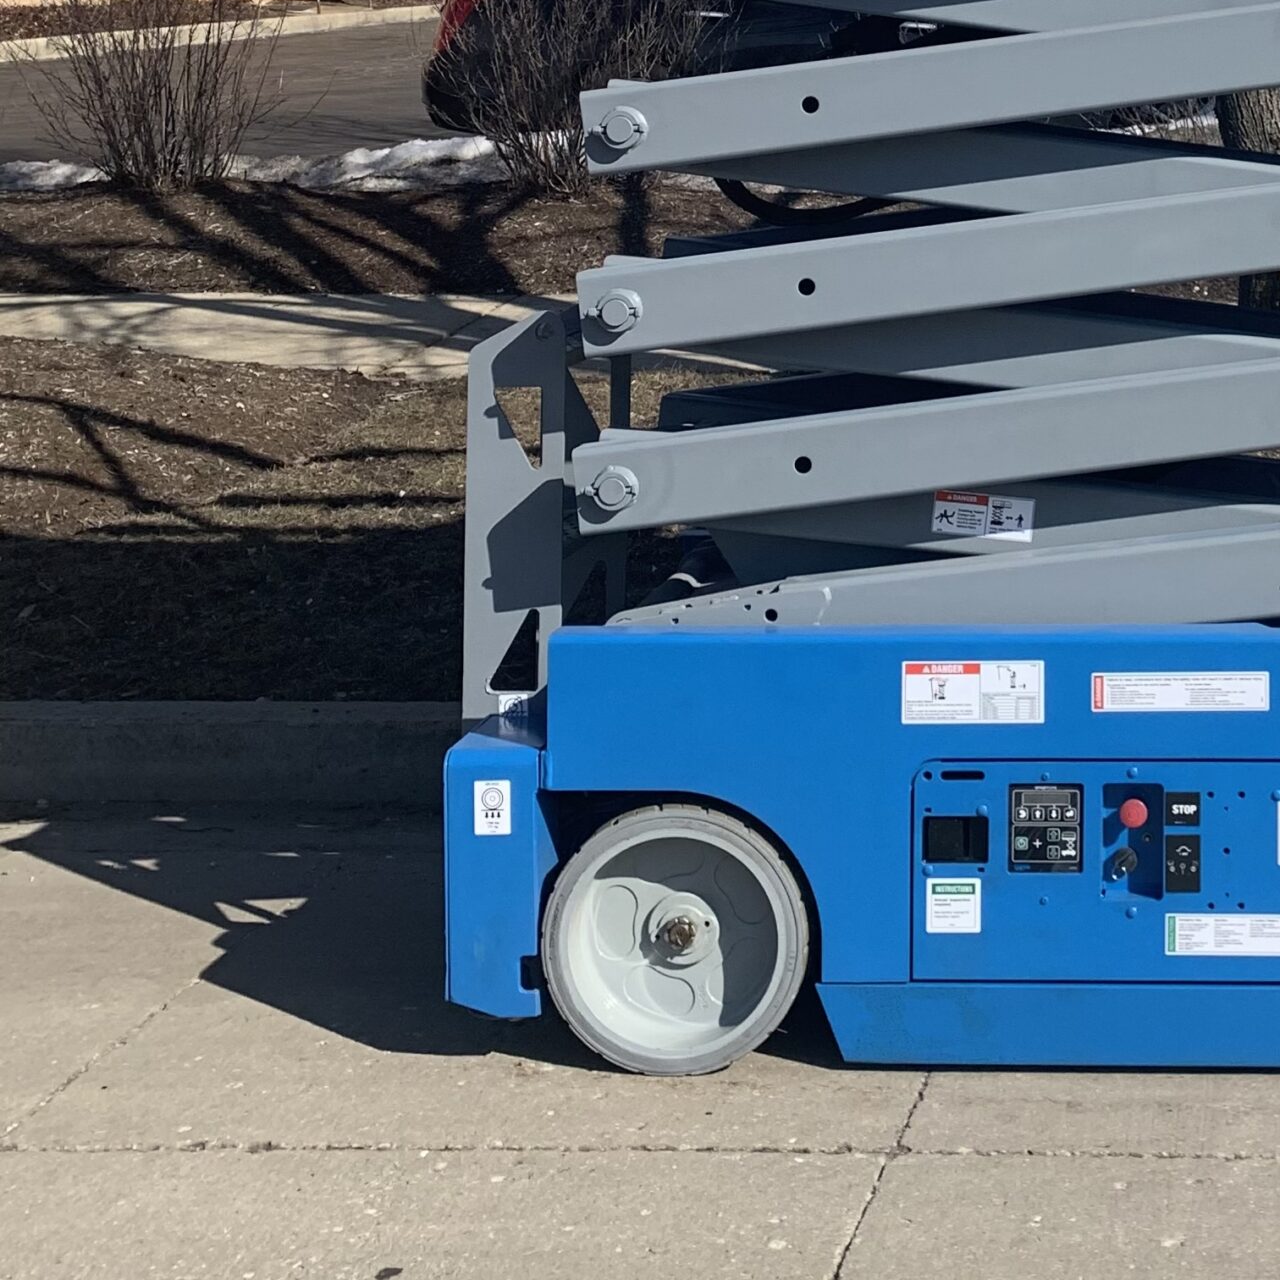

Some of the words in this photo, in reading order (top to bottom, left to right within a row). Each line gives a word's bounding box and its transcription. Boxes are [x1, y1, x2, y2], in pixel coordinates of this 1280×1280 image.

[952, 494, 978, 503] DANGER
[931, 664, 964, 674] DANGER
[1171, 804, 1198, 815] STOP
